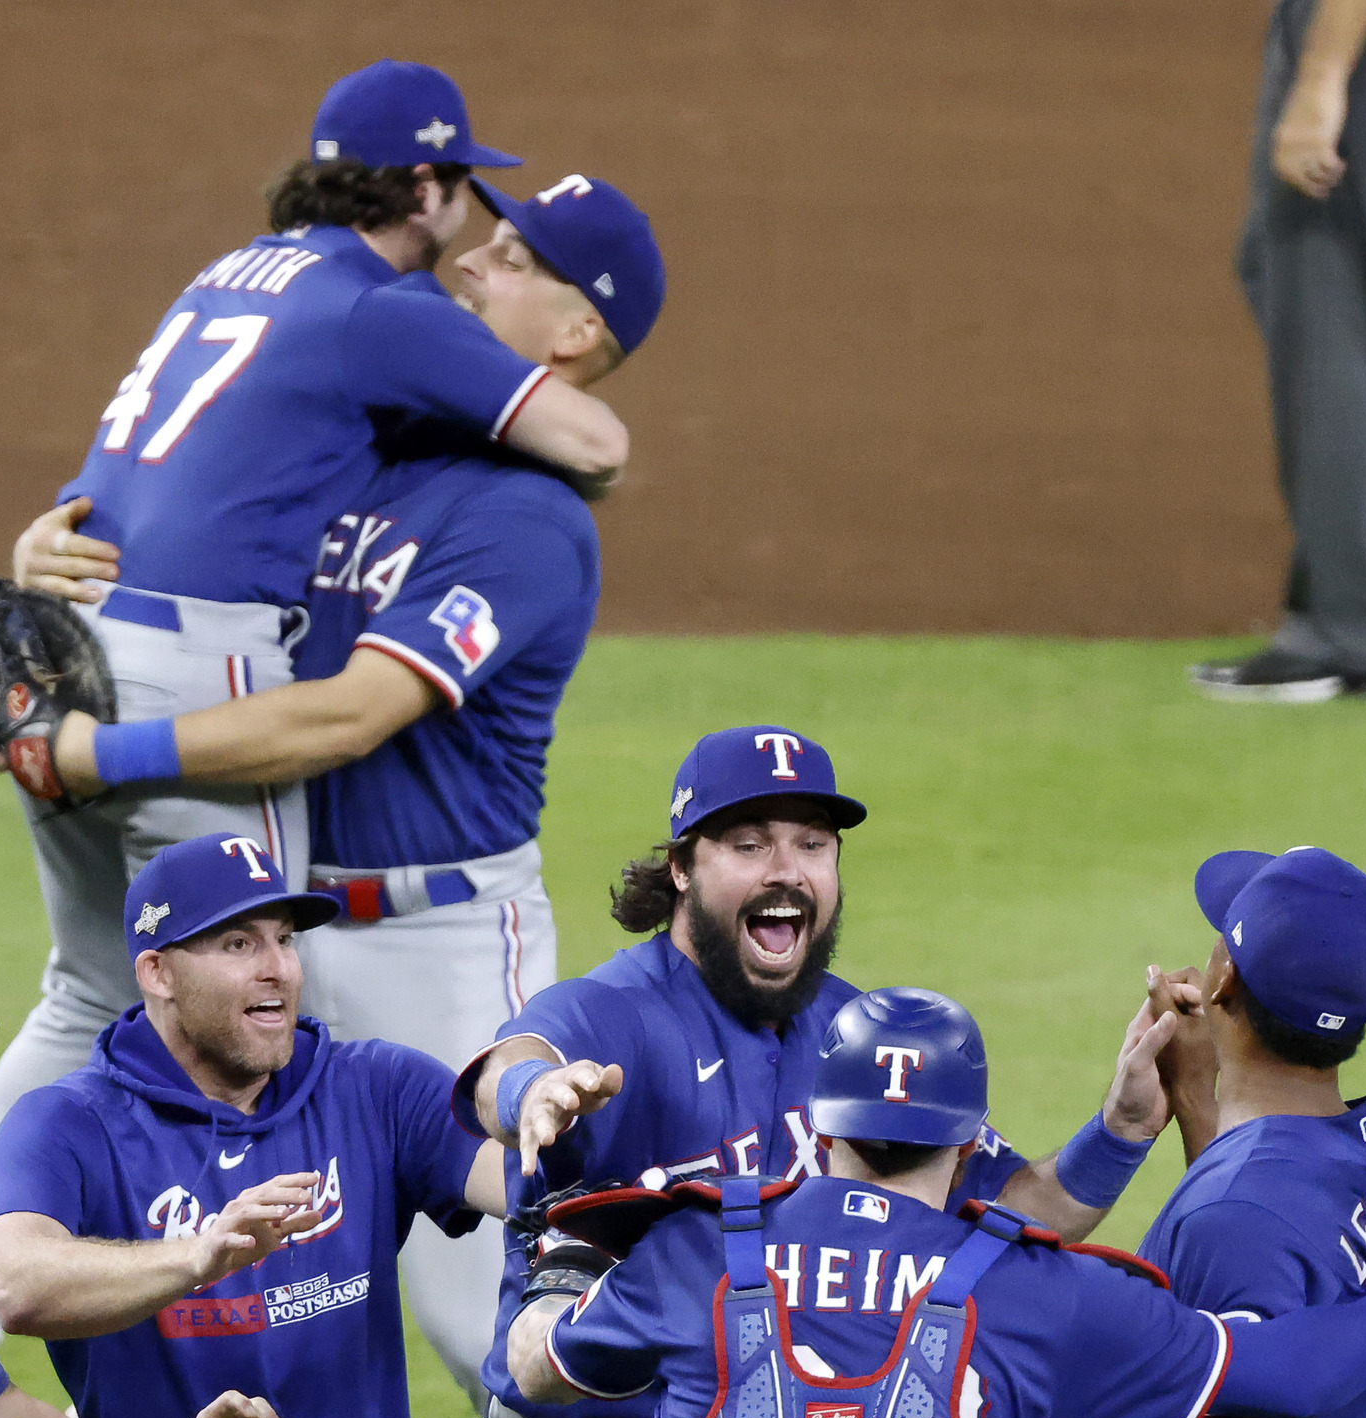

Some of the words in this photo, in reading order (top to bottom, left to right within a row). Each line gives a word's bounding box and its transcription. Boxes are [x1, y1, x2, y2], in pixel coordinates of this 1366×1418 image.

[183, 247, 323, 295] MITH
[100, 311, 273, 464] 47
[754, 733, 804, 781] T
[220, 837, 271, 882] T
[875, 1045, 924, 1102] T
[292, 1276, 330, 1297] 2023
[764, 1243, 947, 1317] HEIM
[172, 1304, 262, 1327] TEXAS
